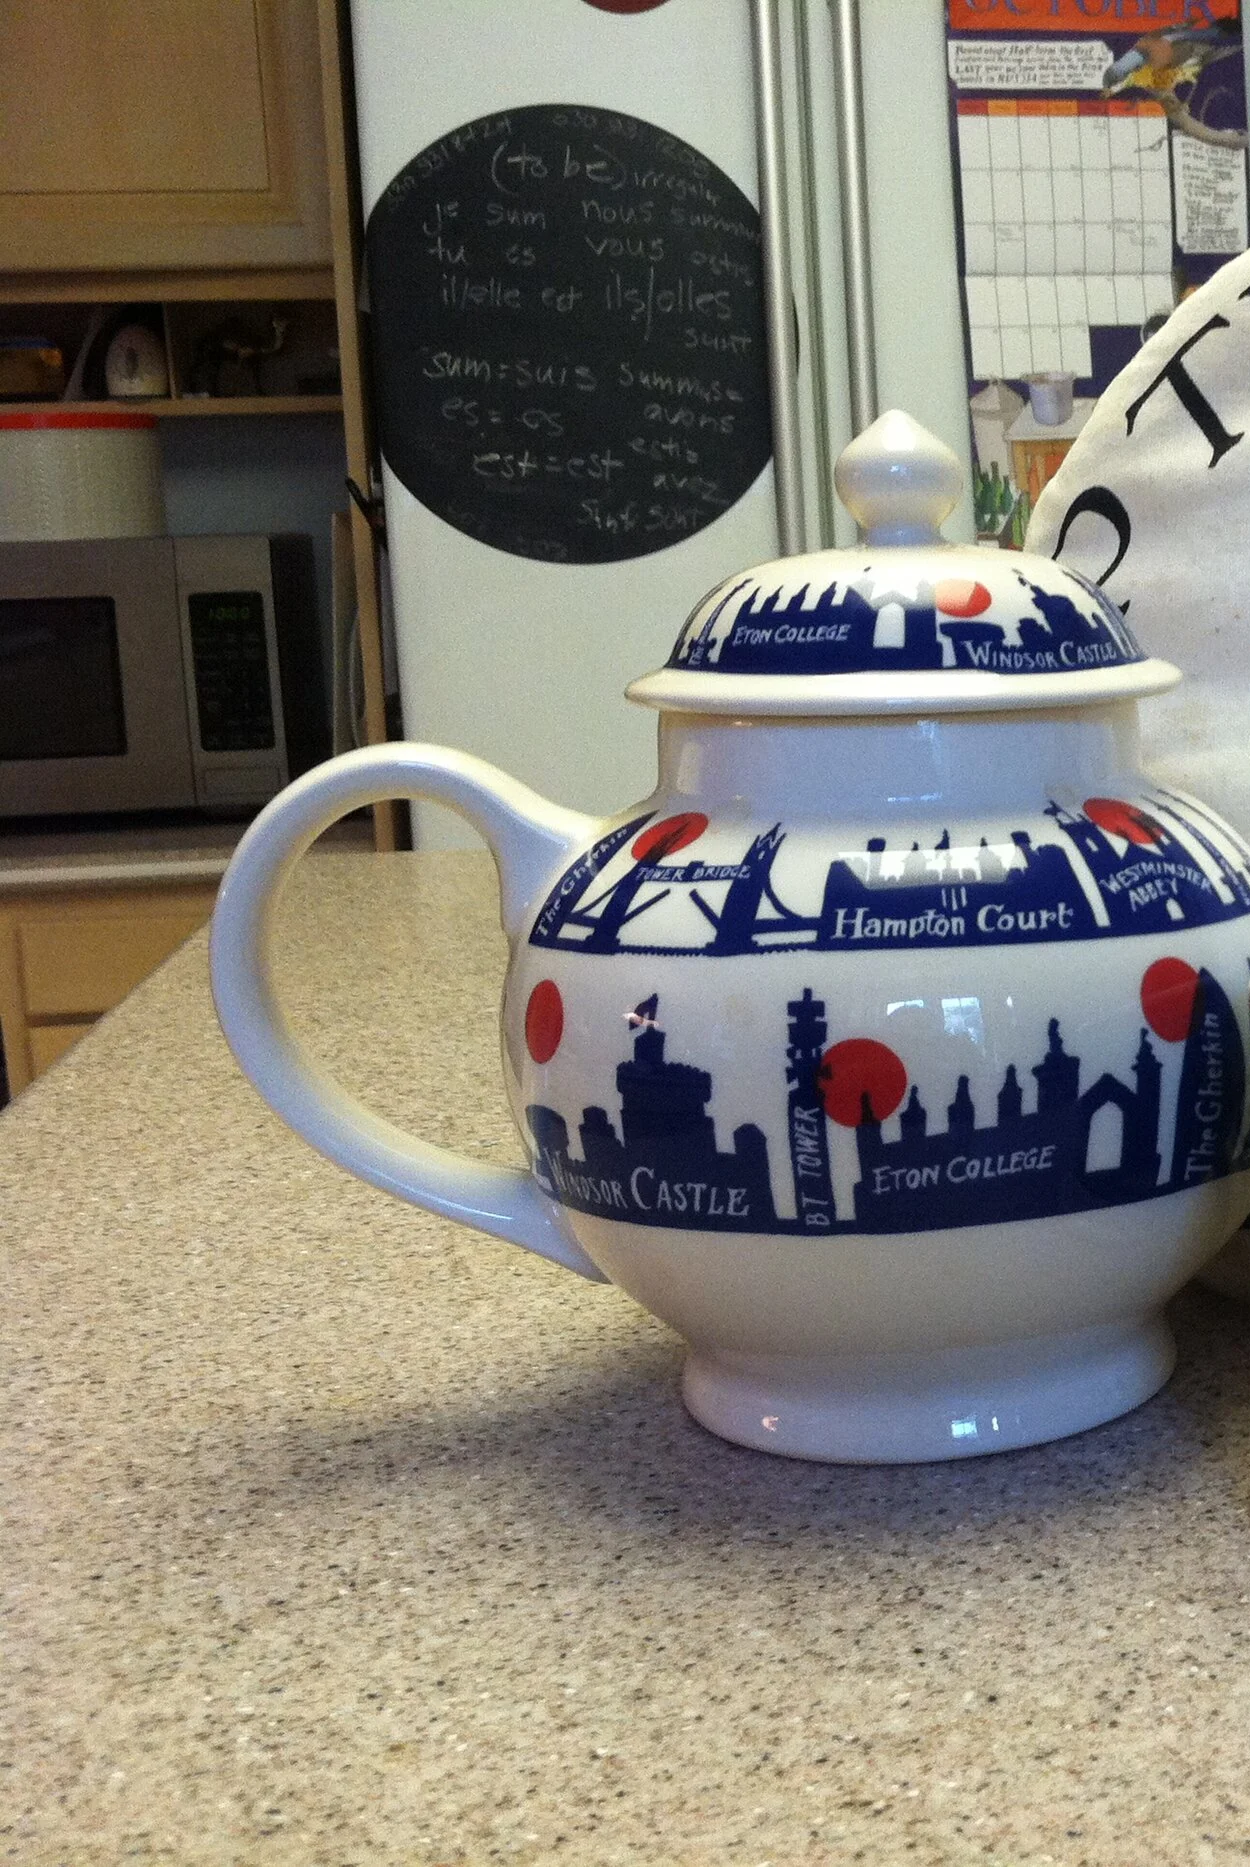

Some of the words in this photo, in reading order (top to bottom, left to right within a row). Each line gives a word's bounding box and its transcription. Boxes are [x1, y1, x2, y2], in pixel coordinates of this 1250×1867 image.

[582, 200, 655, 225] nous
[427, 236, 469, 266] tu
[586, 236, 665, 263] vous
[732, 625, 773, 647] ETON
[774, 623, 852, 644] COLLEGE
[960, 640, 1060, 668] WINDSOR
[1059, 640, 1118, 667] CASTLE
[635, 866, 686, 882] TOWER
[691, 864, 752, 881] BRIDGE
[1101, 860, 1213, 895] WESTMINSTER
[1129, 876, 1180, 912] ABBEY
[831, 905, 965, 940] Hampton
[976, 902, 1074, 934] Court
[1194, 1012, 1224, 1123] Gherkin
[794, 1104, 823, 1179] TOWER
[1183, 1127, 1218, 1182] The
[872, 1164, 940, 1196] ETON
[946, 1144, 1057, 1183] COLLEGE
[629, 1165, 751, 1217] CASTLE
[802, 1195, 831, 1227] BT
